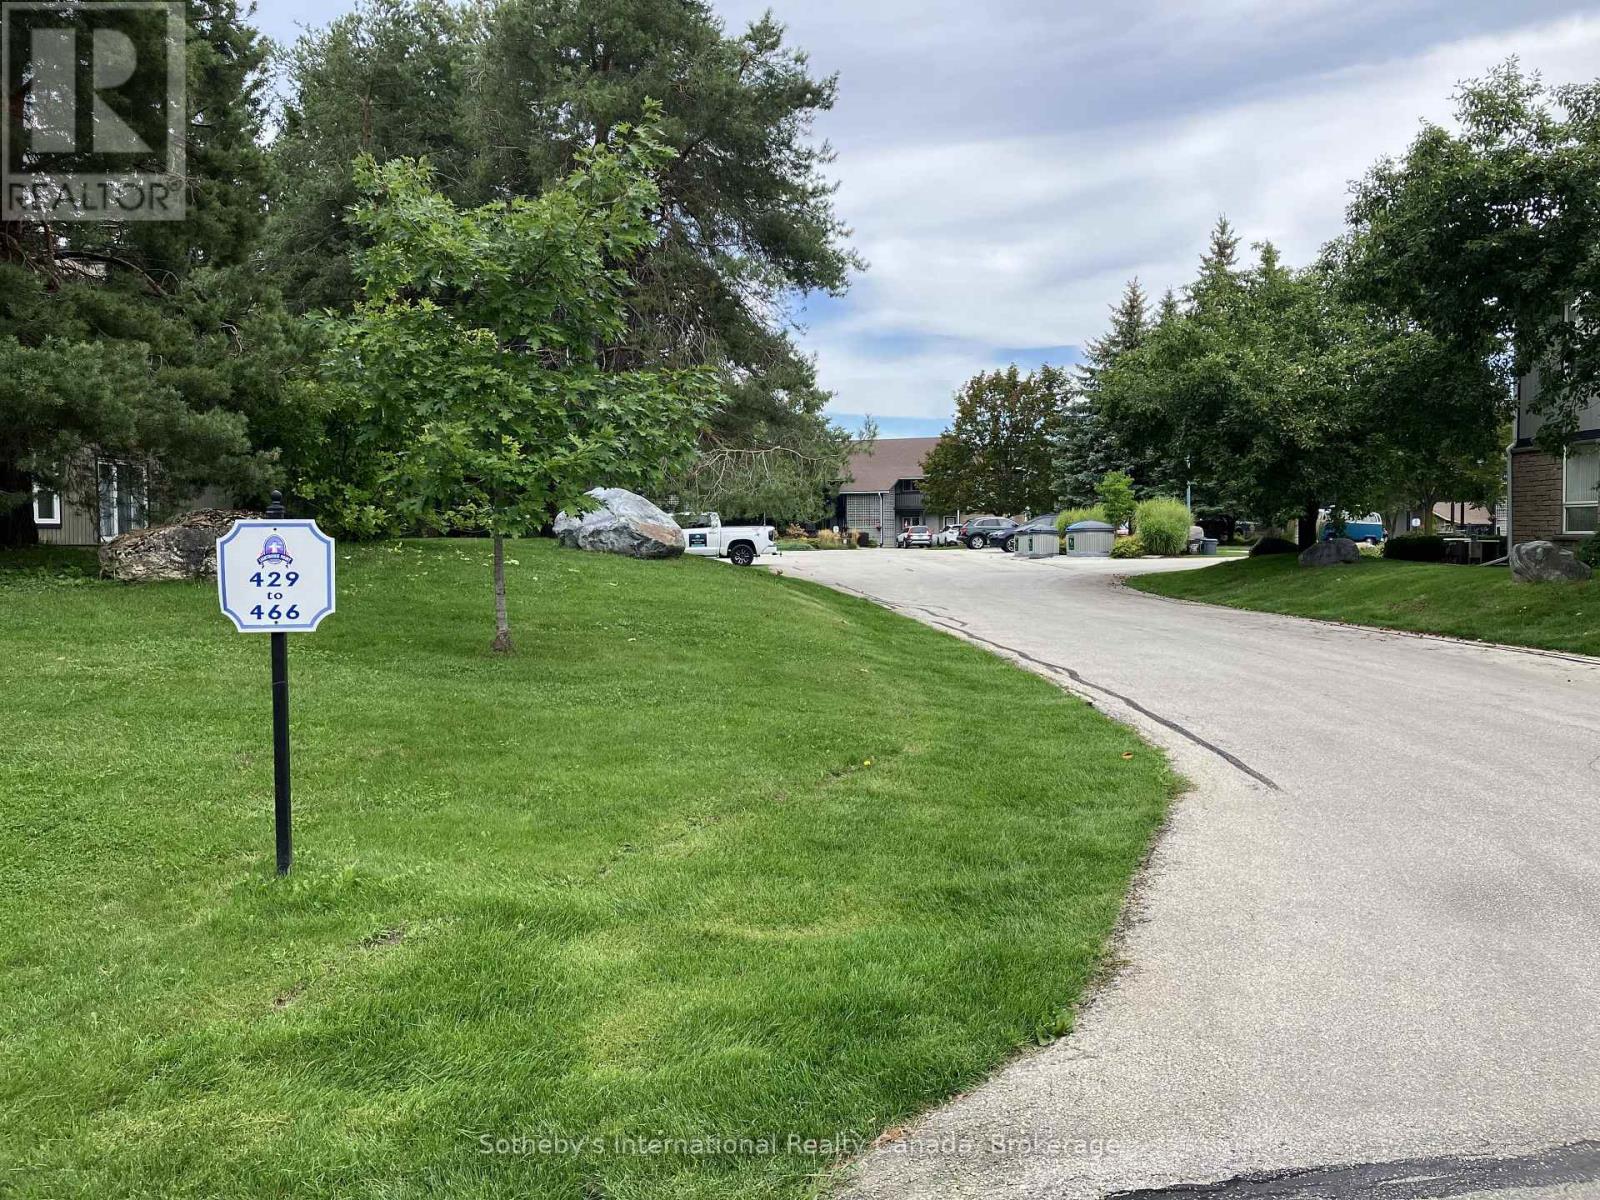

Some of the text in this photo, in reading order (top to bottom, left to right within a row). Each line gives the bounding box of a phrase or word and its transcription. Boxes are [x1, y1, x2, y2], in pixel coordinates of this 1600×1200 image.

[249, 571, 299, 588] 429
[267, 592, 283, 600] to
[250, 604, 300, 620] 466
